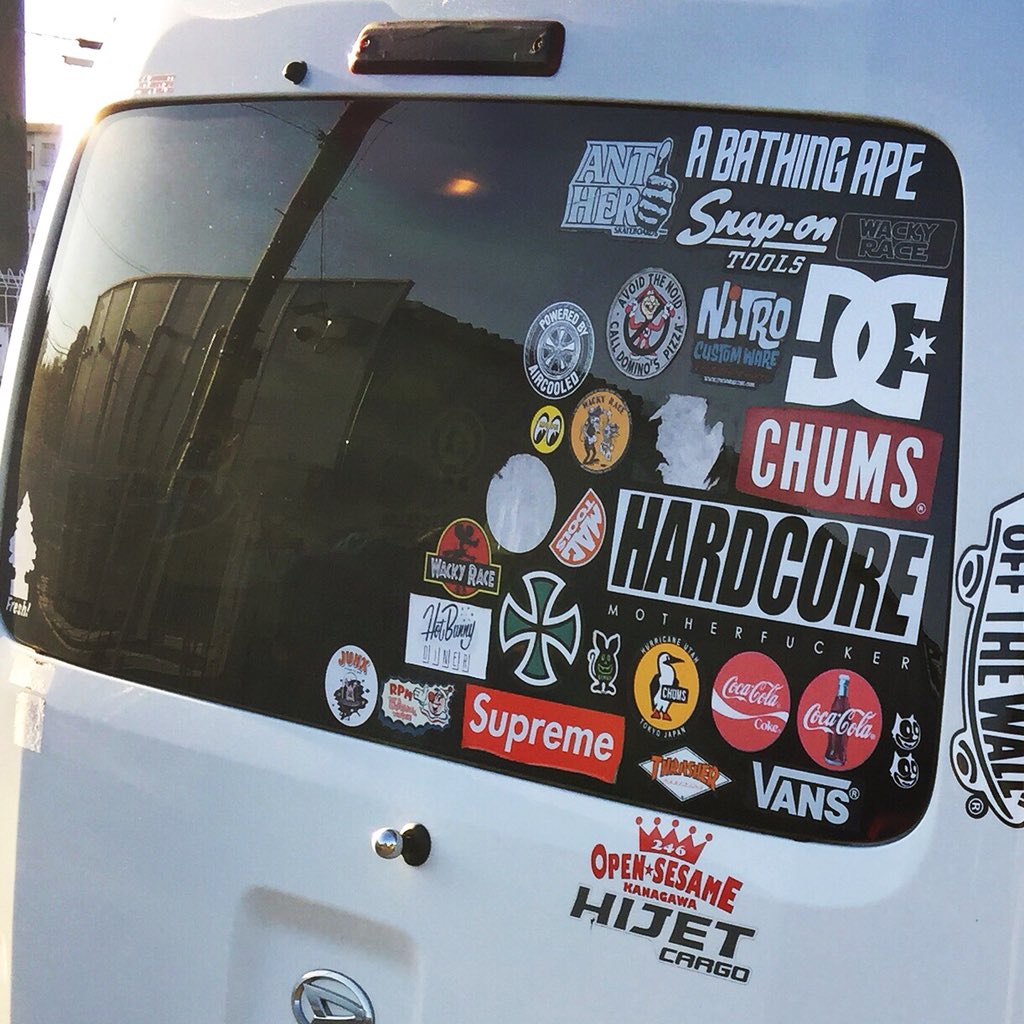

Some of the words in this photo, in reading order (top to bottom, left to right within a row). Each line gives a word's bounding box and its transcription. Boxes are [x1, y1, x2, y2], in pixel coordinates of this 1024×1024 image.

[685, 126, 713, 178] A
[711, 128, 852, 195] BATHING
[850, 140, 926, 200] APE
[676, 188, 838, 247] Snap-on
[859, 217, 940, 242] WACKY
[726, 250, 807, 274] TOOLS
[858, 240, 929, 262] RACE
[618, 276, 646, 309] AVOID
[649, 273, 667, 288] THE
[667, 280, 683, 310] NOID
[538, 308, 580, 331] POWERED
[576, 318, 589, 337] BY
[609, 321, 621, 353] CALL
[616, 351, 661, 376] DOMINO'S
[663, 322, 684, 360] PIZZA
[528, 363, 580, 396] AIRCOOLED
[751, 418, 924, 510] CHUMS
[430, 557, 466, 582] WACKY
[467, 563, 496, 588] RACE
[611, 493, 931, 638] HARDCORE
[607, 604, 911, 671] MOTHERFUCKER
[641, 635, 683, 654] HURRICANE
[683, 642, 700, 664] UTAH
[389, 682, 414, 701] RPM
[661, 685, 688, 702] CHUMS
[722, 675, 784, 708] Coca-Cola
[468, 692, 615, 762] Supreme
[639, 718, 661, 738] TOKYO
[663, 726, 687, 739] JAPAN
[753, 717, 780, 733] Coke
[802, 702, 877, 740] Coca-Cola
[752, 761, 852, 825] VANS
[651, 839, 687, 857] 246
[591, 843, 647, 881] OPEN
[652, 857, 744, 914] SESAME
[623, 881, 698, 910] KANAGAWA
[570, 885, 757, 960] HIJET
[658, 946, 750, 984] CARGO
